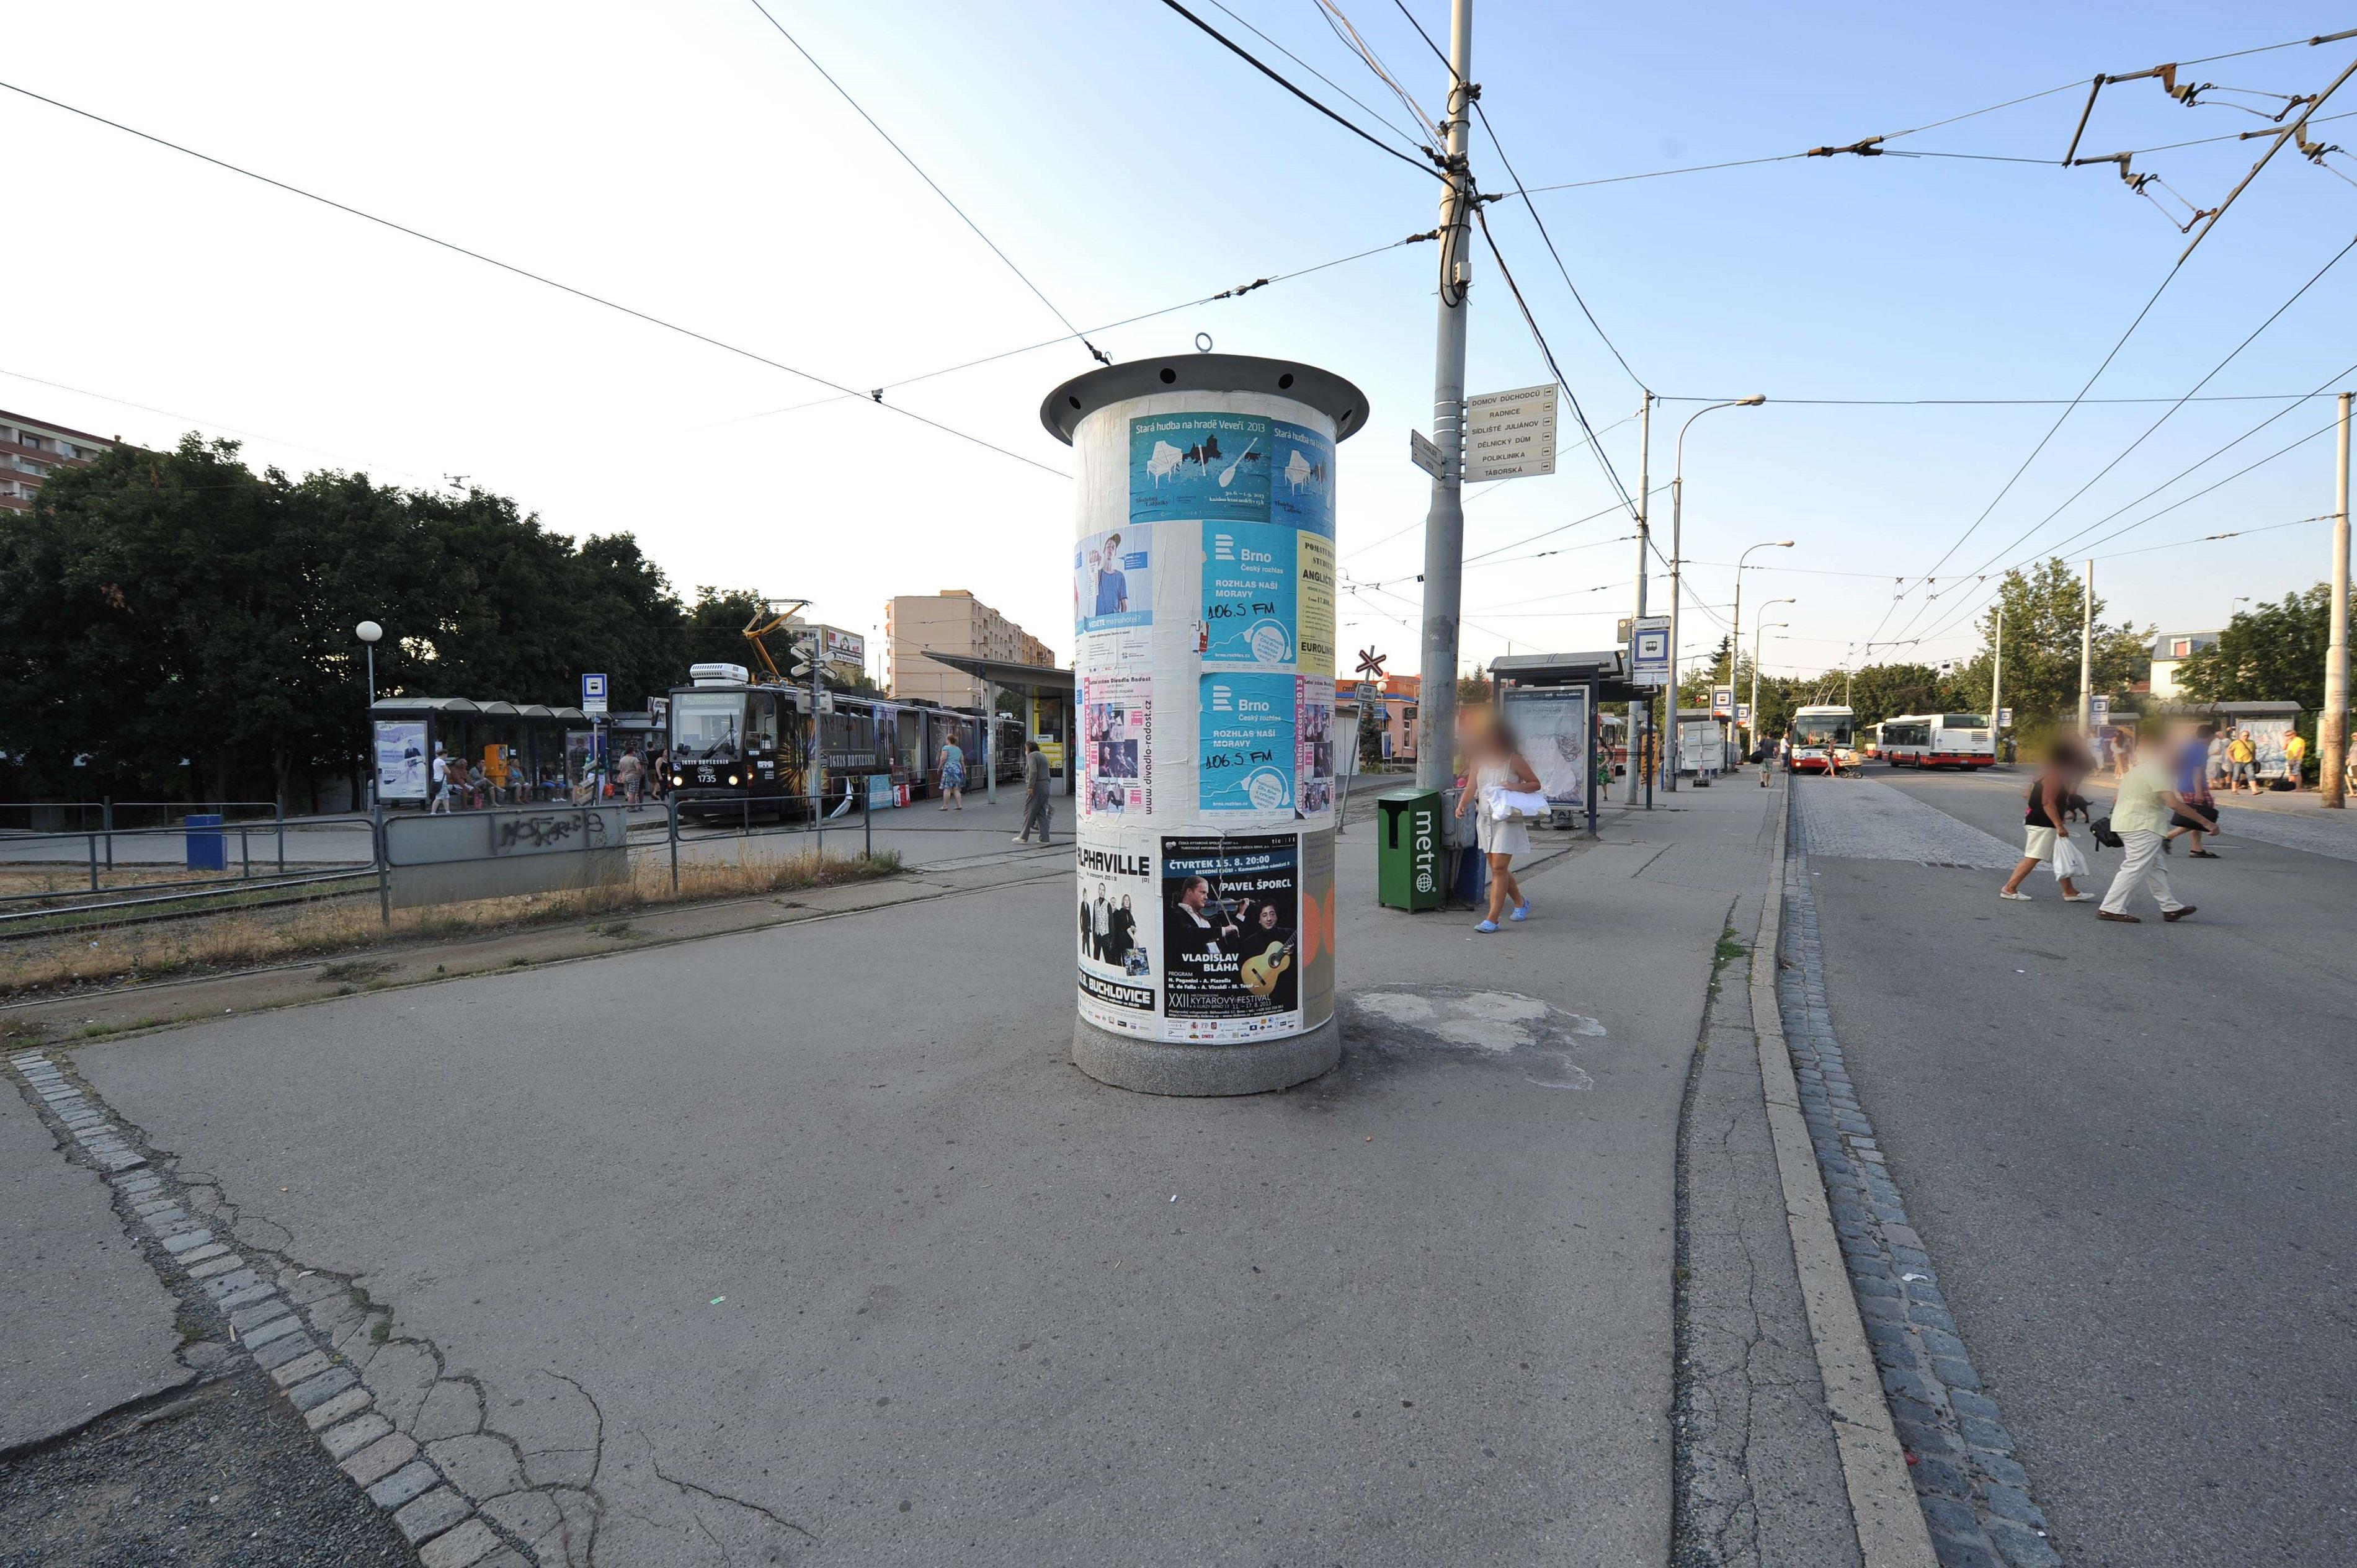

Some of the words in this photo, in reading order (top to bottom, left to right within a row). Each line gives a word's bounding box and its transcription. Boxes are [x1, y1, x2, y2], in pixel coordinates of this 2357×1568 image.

[1472, 398, 1497, 406] DOMOV
[1500, 390, 1540, 402] DŮCHODCŮ
[1489, 408, 1521, 418] RADNICE
[1136, 422, 1155, 434] Stará
[1156, 421, 1180, 431] hudba
[1193, 419, 1217, 429] hradě
[1219, 420, 1244, 430] Veveří
[1247, 422, 1265, 432] 2013
[1505, 421, 1539, 430] JULIÁNOV
[1274, 428, 1291, 439] Stará
[1515, 435, 1531, 443] DŮM
[1482, 452, 1525, 462] POLIKLINIKA
[1485, 466, 1523, 476] TÁBORSKÁ
[1241, 548, 1272, 563] Brno
[1241, 563, 1261, 573] Český
[1262, 566, 1283, 574] rozhlas
[1215, 579, 1257, 589] ROZHLAS
[1259, 581, 1278, 590] NAŠÍ
[1215, 590, 1254, 599] MORAVY
[1251, 601, 1276, 615] FM
[1239, 699, 1269, 711] Brno
[1238, 714, 1259, 723] Český
[1296, 708, 1304, 741] večery
[1256, 729, 1276, 737] NAŠÍ
[830, 754, 846, 768] IGNIS
[1143, 700, 1152, 815] www.divadlo-radost.cz
[1249, 749, 1273, 764] FM
[697, 775, 716, 783] 1735
[1077, 846, 1150, 876] ALPHAVILLE
[1169, 859, 1213, 870] ČTVRTEK
[1234, 858, 1243, 866] 8.
[1245, 855, 1270, 866] 20:00
[1238, 865, 1270, 873] Komenského
[1221, 881, 1254, 892] PAVEL
[1257, 878, 1292, 891] ŠPORCL
[1182, 953, 1239, 962] VLADISLAV
[1203, 961, 1239, 972] BLÁHA
[1089, 978, 1151, 1005] BUCHLOVICE
[1169, 992, 1192, 1008] XXII.
[1190, 995, 1234, 1005] KYTAROVÝ
[1237, 994, 1271, 1004] FESTIVAL
